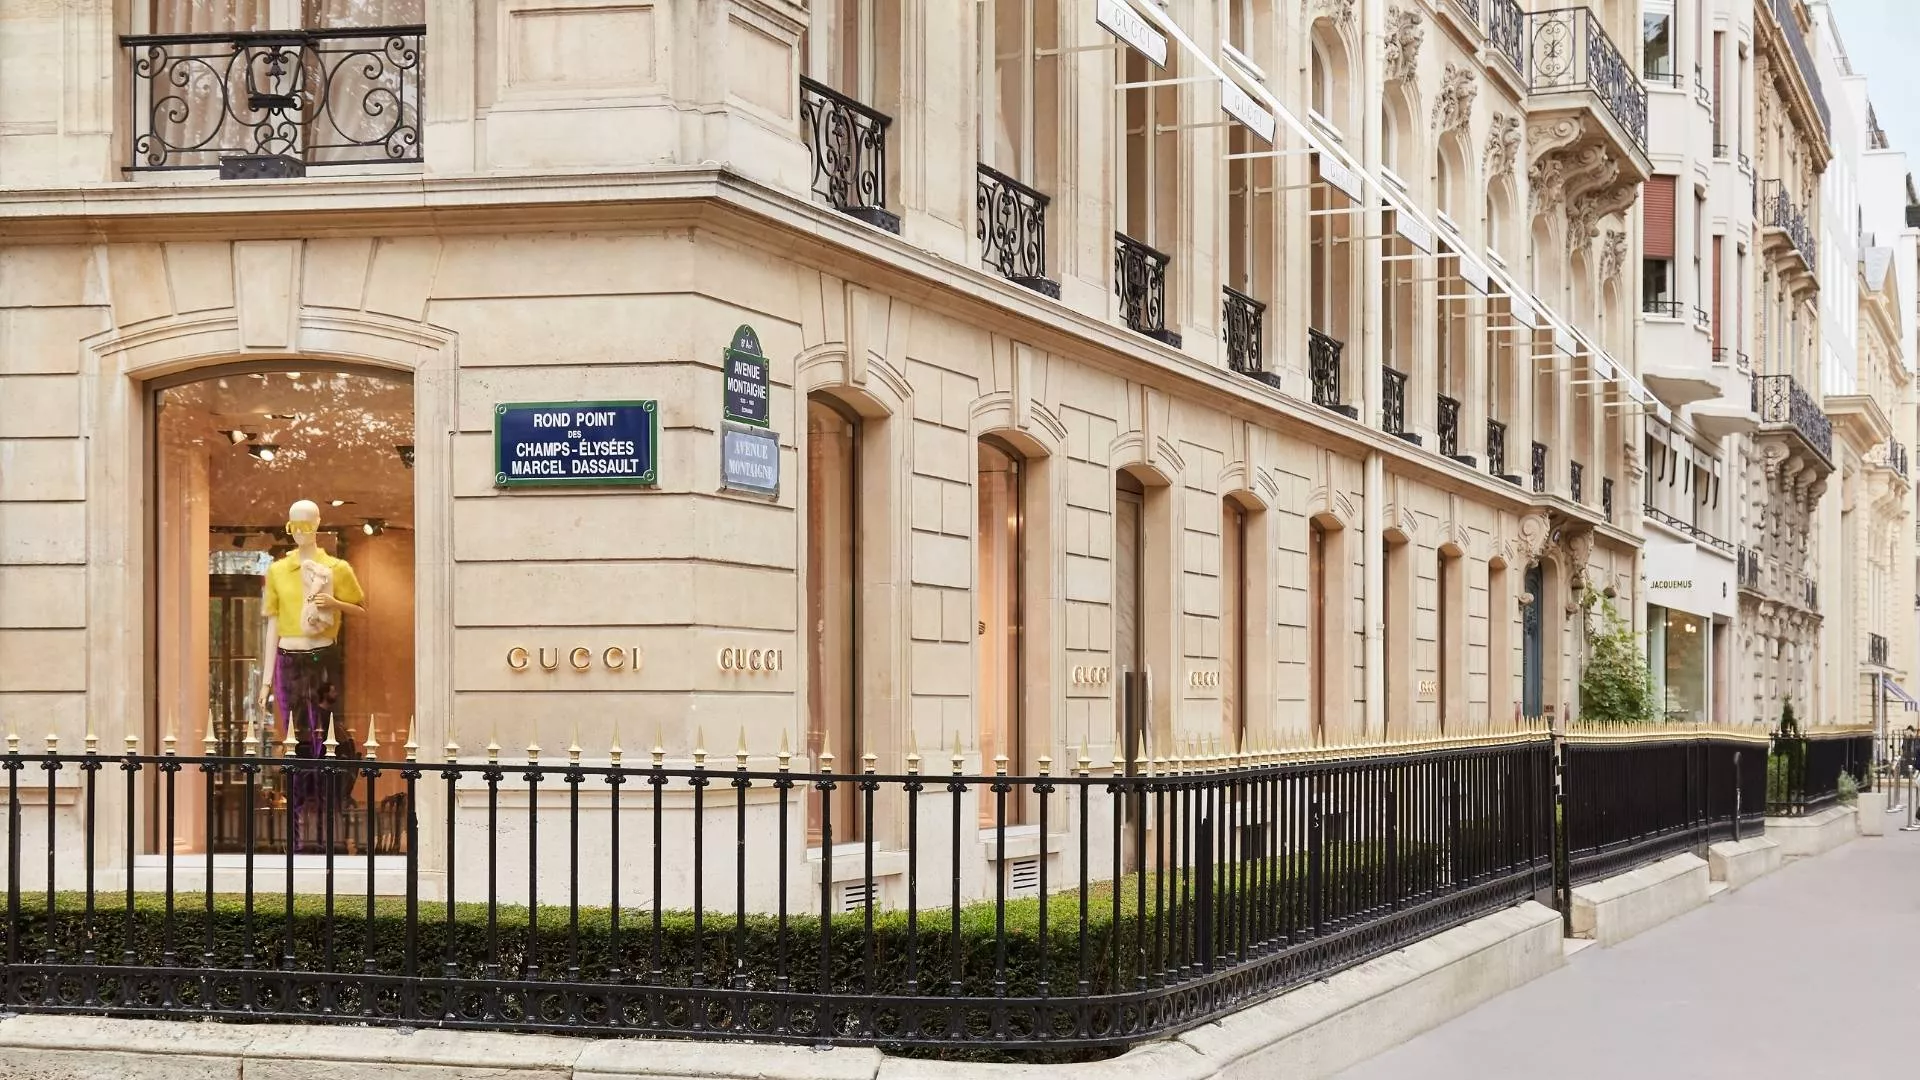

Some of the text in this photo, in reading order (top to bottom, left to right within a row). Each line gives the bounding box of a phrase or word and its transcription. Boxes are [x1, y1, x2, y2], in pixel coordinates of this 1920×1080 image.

[1115, 8, 1150, 48] GUCCI
[734, 361, 761, 380] AVENUE
[727, 377, 766, 399] MONTAIGNE
[533, 412, 616, 427] ROND POINT
[567, 430, 582, 438] DES
[734, 441, 768, 460] AVENUE
[511, 459, 639, 475] MARCEL DASSAULT
[728, 459, 773, 480] MONTAIGNE
[1650, 580, 1693, 589] JACQUEMUS
[506, 646, 641, 671] GUCCI
[717, 647, 783, 671] GUCCI
